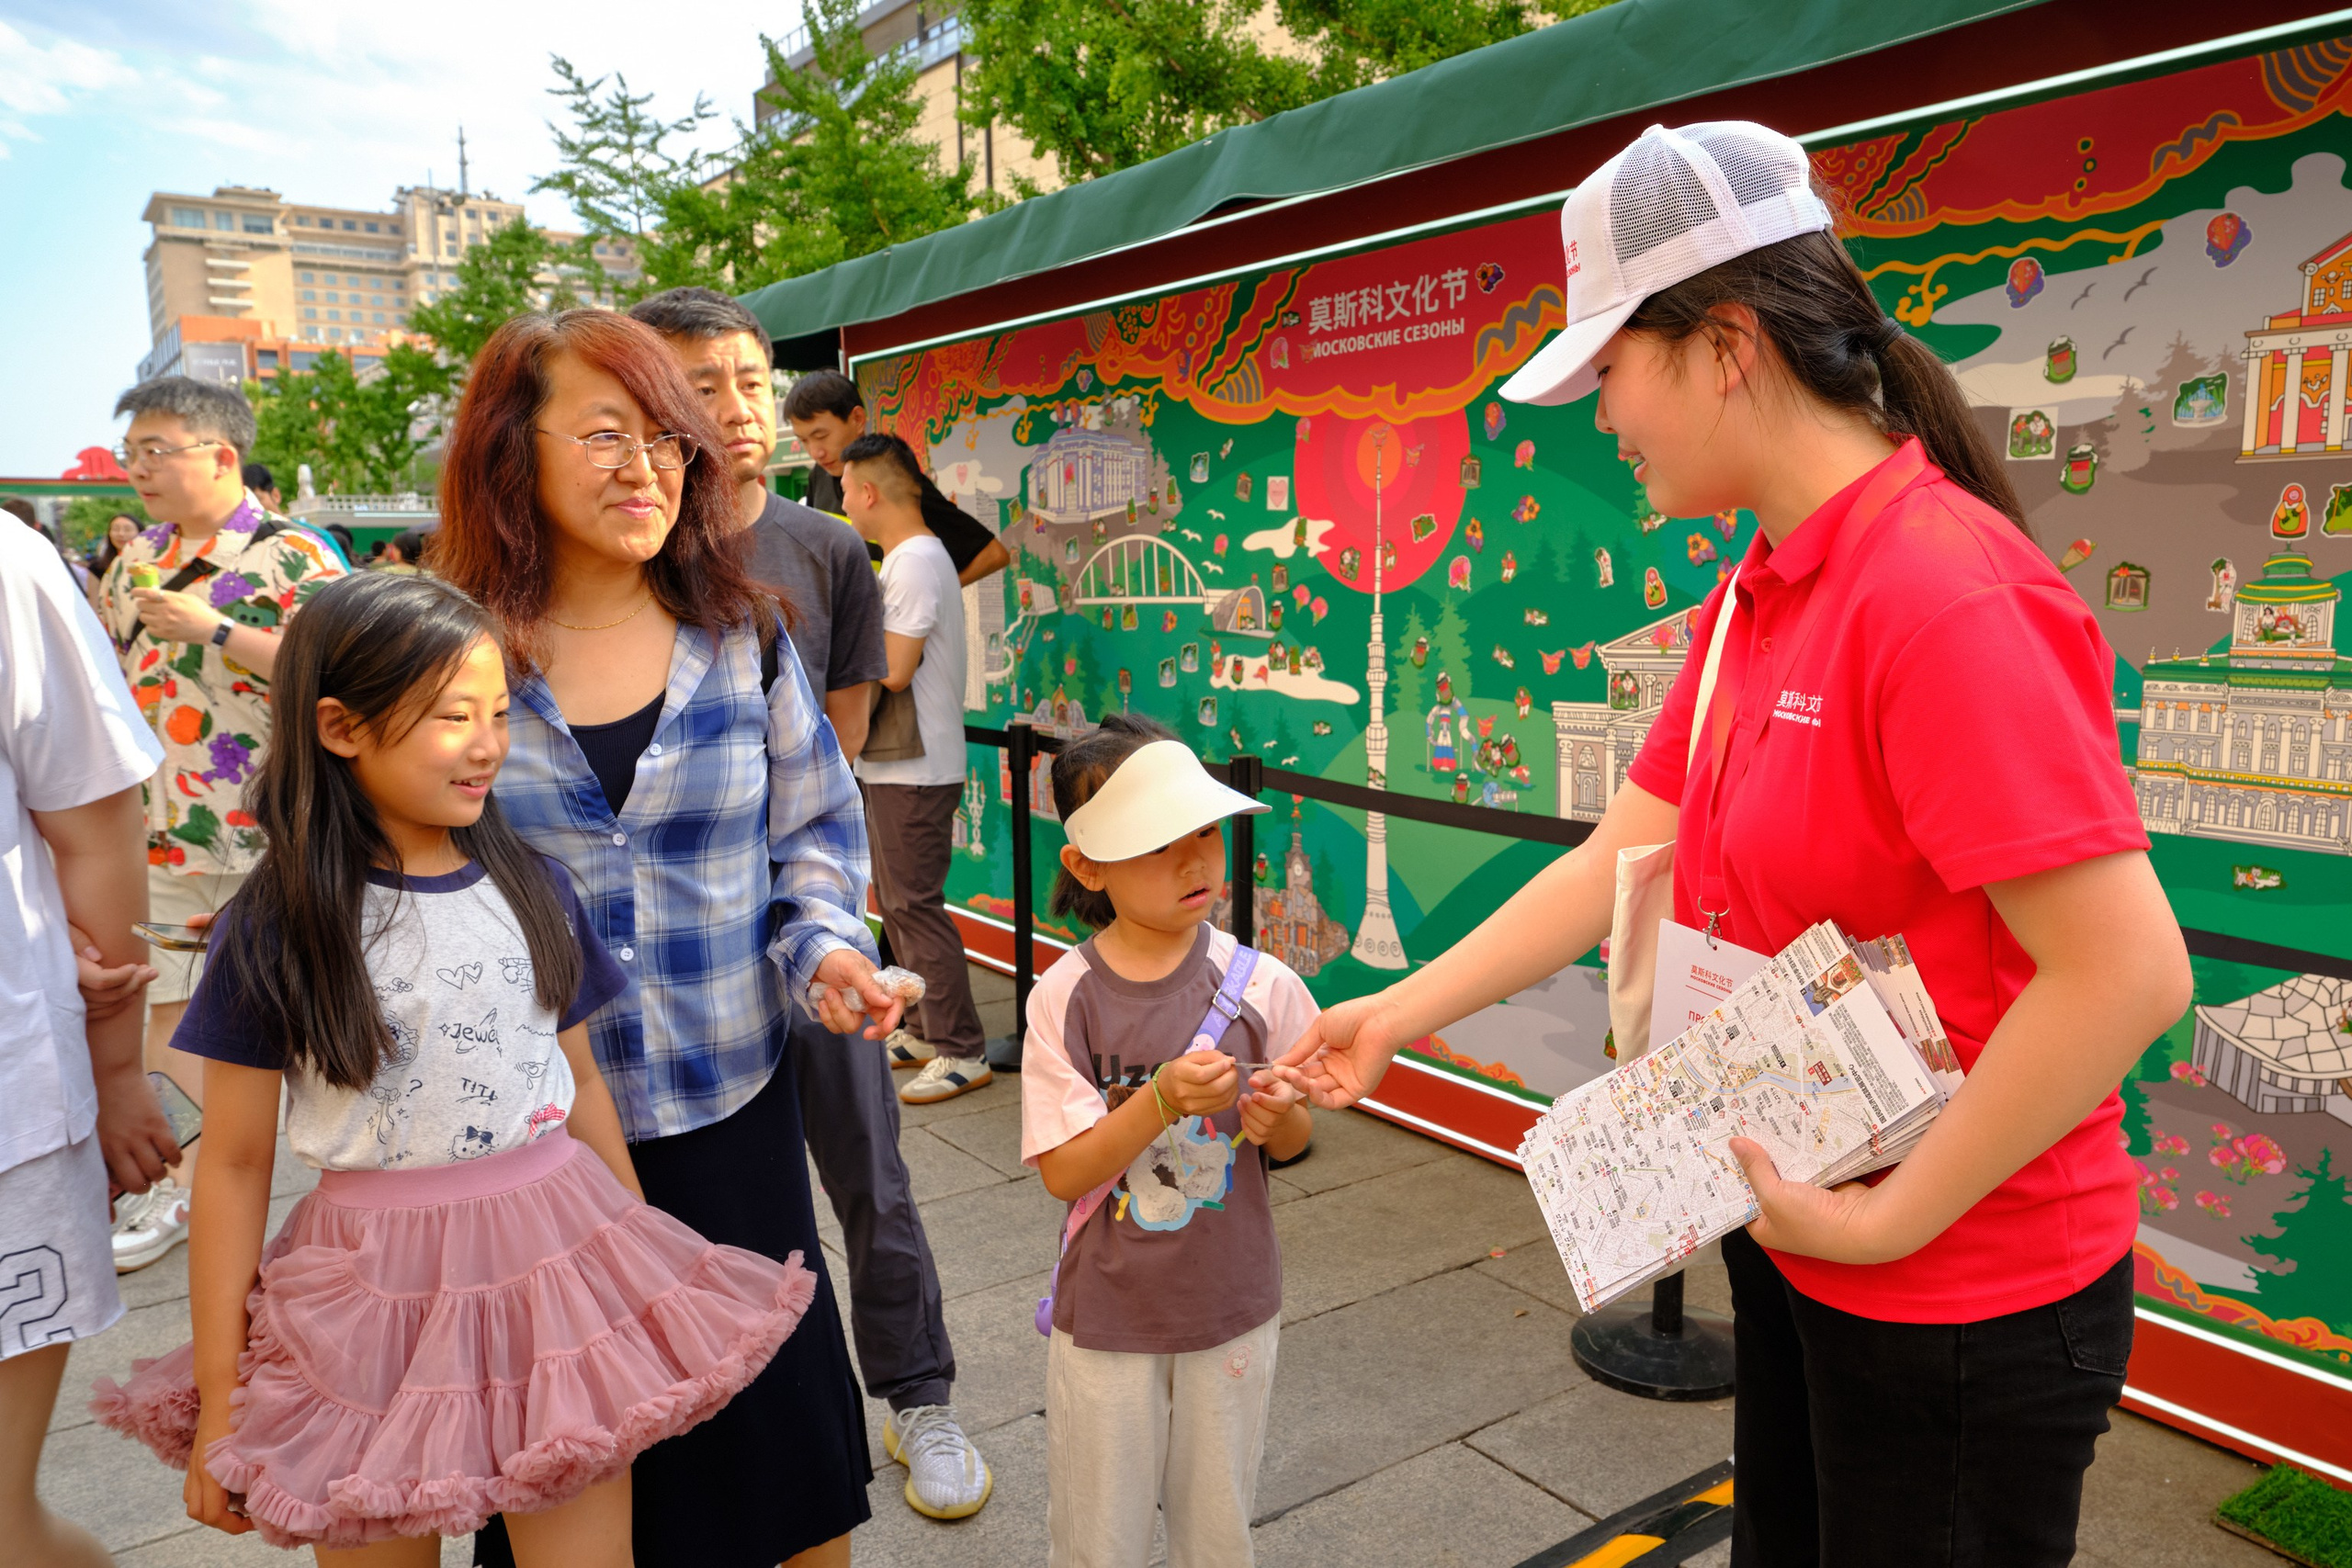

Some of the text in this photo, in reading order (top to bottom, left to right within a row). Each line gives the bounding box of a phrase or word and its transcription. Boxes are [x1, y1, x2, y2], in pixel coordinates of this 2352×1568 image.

[1308, 266, 1469, 335] 莫斯科文化节
[1403, 317, 1465, 344] СЕЗОНЫ
[1690, 964, 1734, 987] 莫斯科文化节
